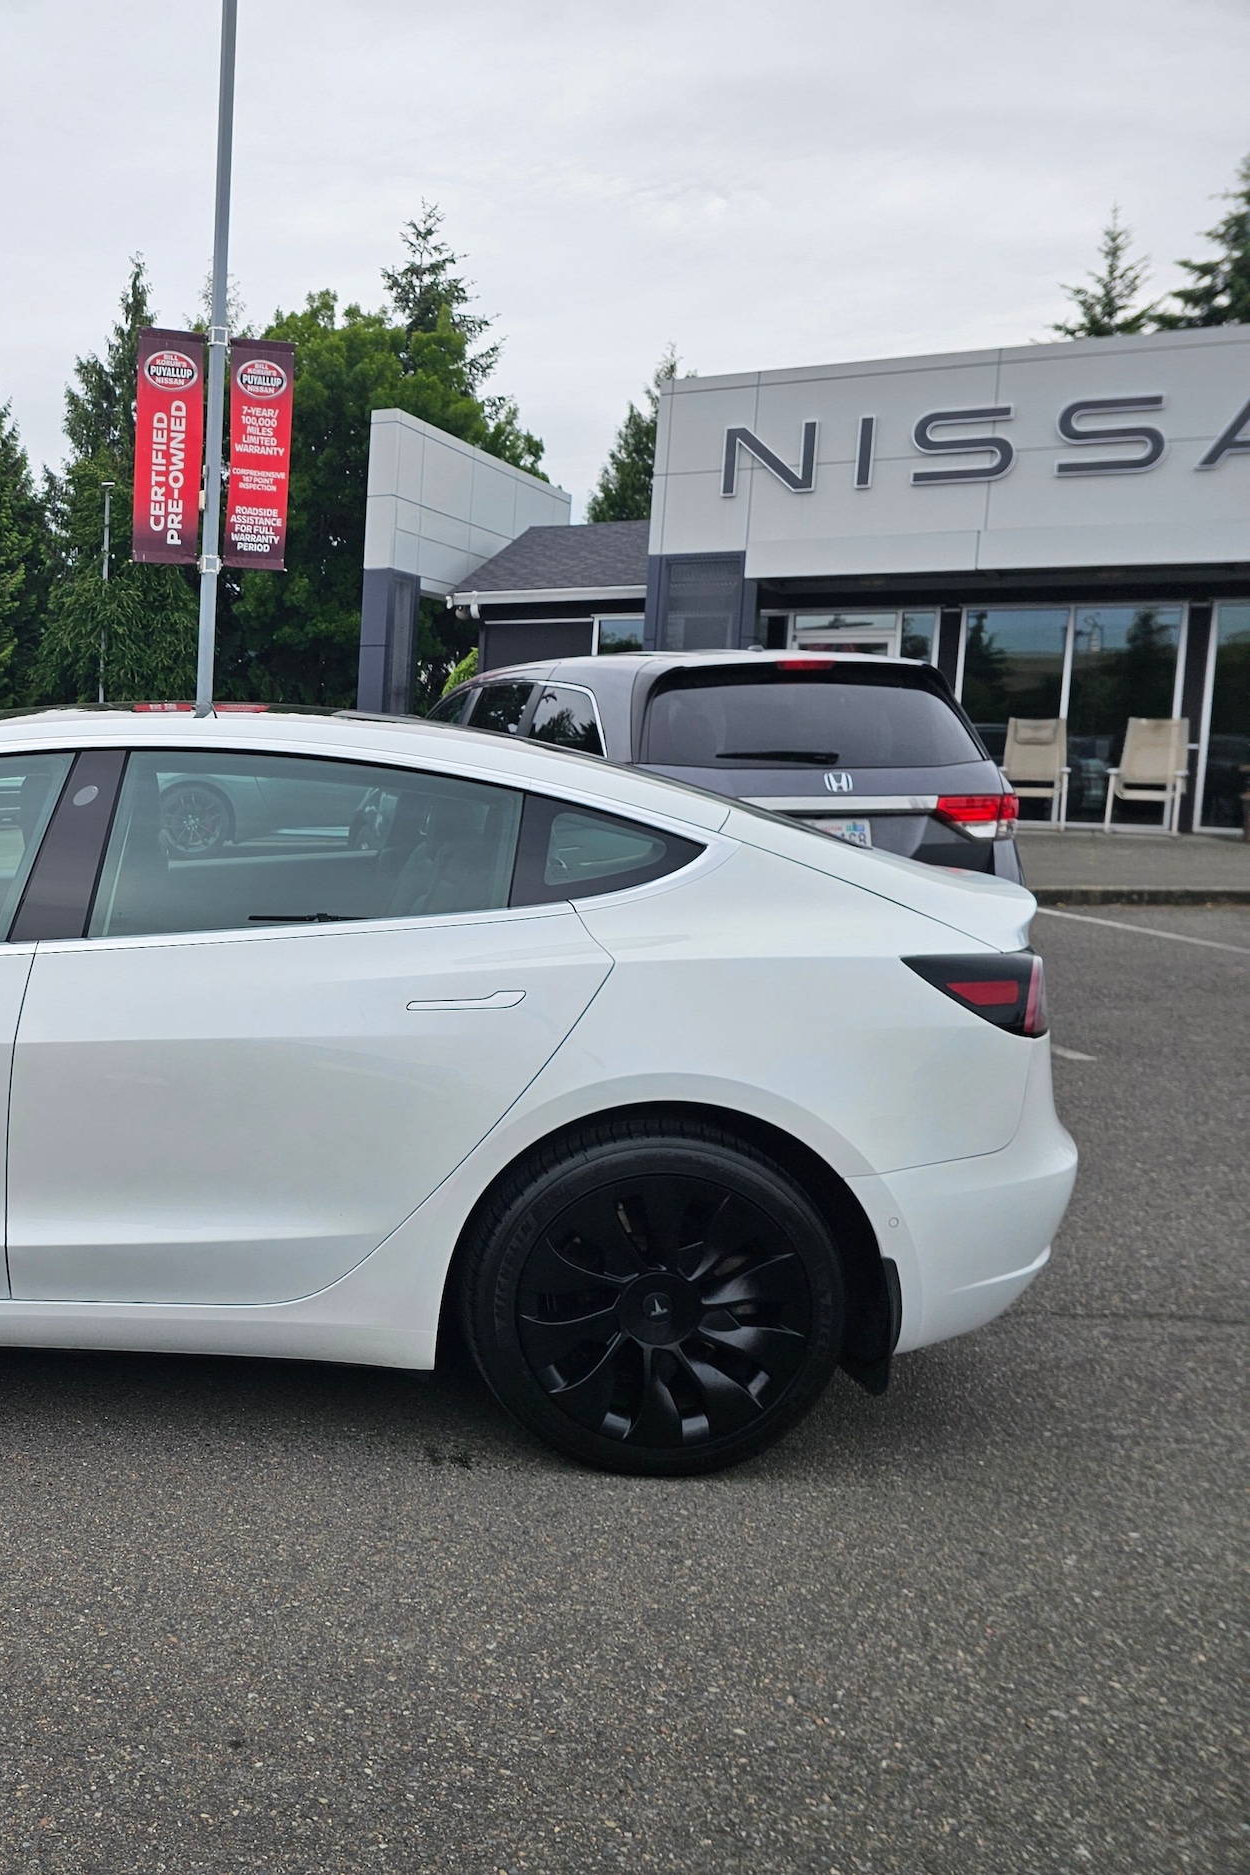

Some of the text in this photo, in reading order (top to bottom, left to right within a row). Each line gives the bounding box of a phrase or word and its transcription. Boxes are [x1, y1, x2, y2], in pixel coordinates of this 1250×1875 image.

[150, 365, 193, 378] PUYALLUP
[156, 377, 185, 385] NISSAN
[242, 373, 282, 387] PUYALLUP
[247, 385, 275, 393] NISSAN
[242, 405, 279, 418] 7-YEAR/
[241, 415, 277, 427] 100,000
[247, 425, 273, 436] MILES
[242, 434, 277, 446] LIMITED
[234, 443, 285, 456] WARRANTY
[149, 412, 168, 531] CERTIFIED
[166, 400, 187, 545] PRE-OWNED
[232, 467, 286, 479] COMPREHENSIVE
[253, 476, 274, 484] POINT
[238, 482, 277, 492] INSPECTION
[235, 505, 278, 517] ROADSIDE
[230, 514, 282, 527] ASSISTANCE
[235, 524, 275, 535] FOR FULL
[231, 532, 280, 544] WARRANTY
[237, 542, 270, 553] PERIOD
